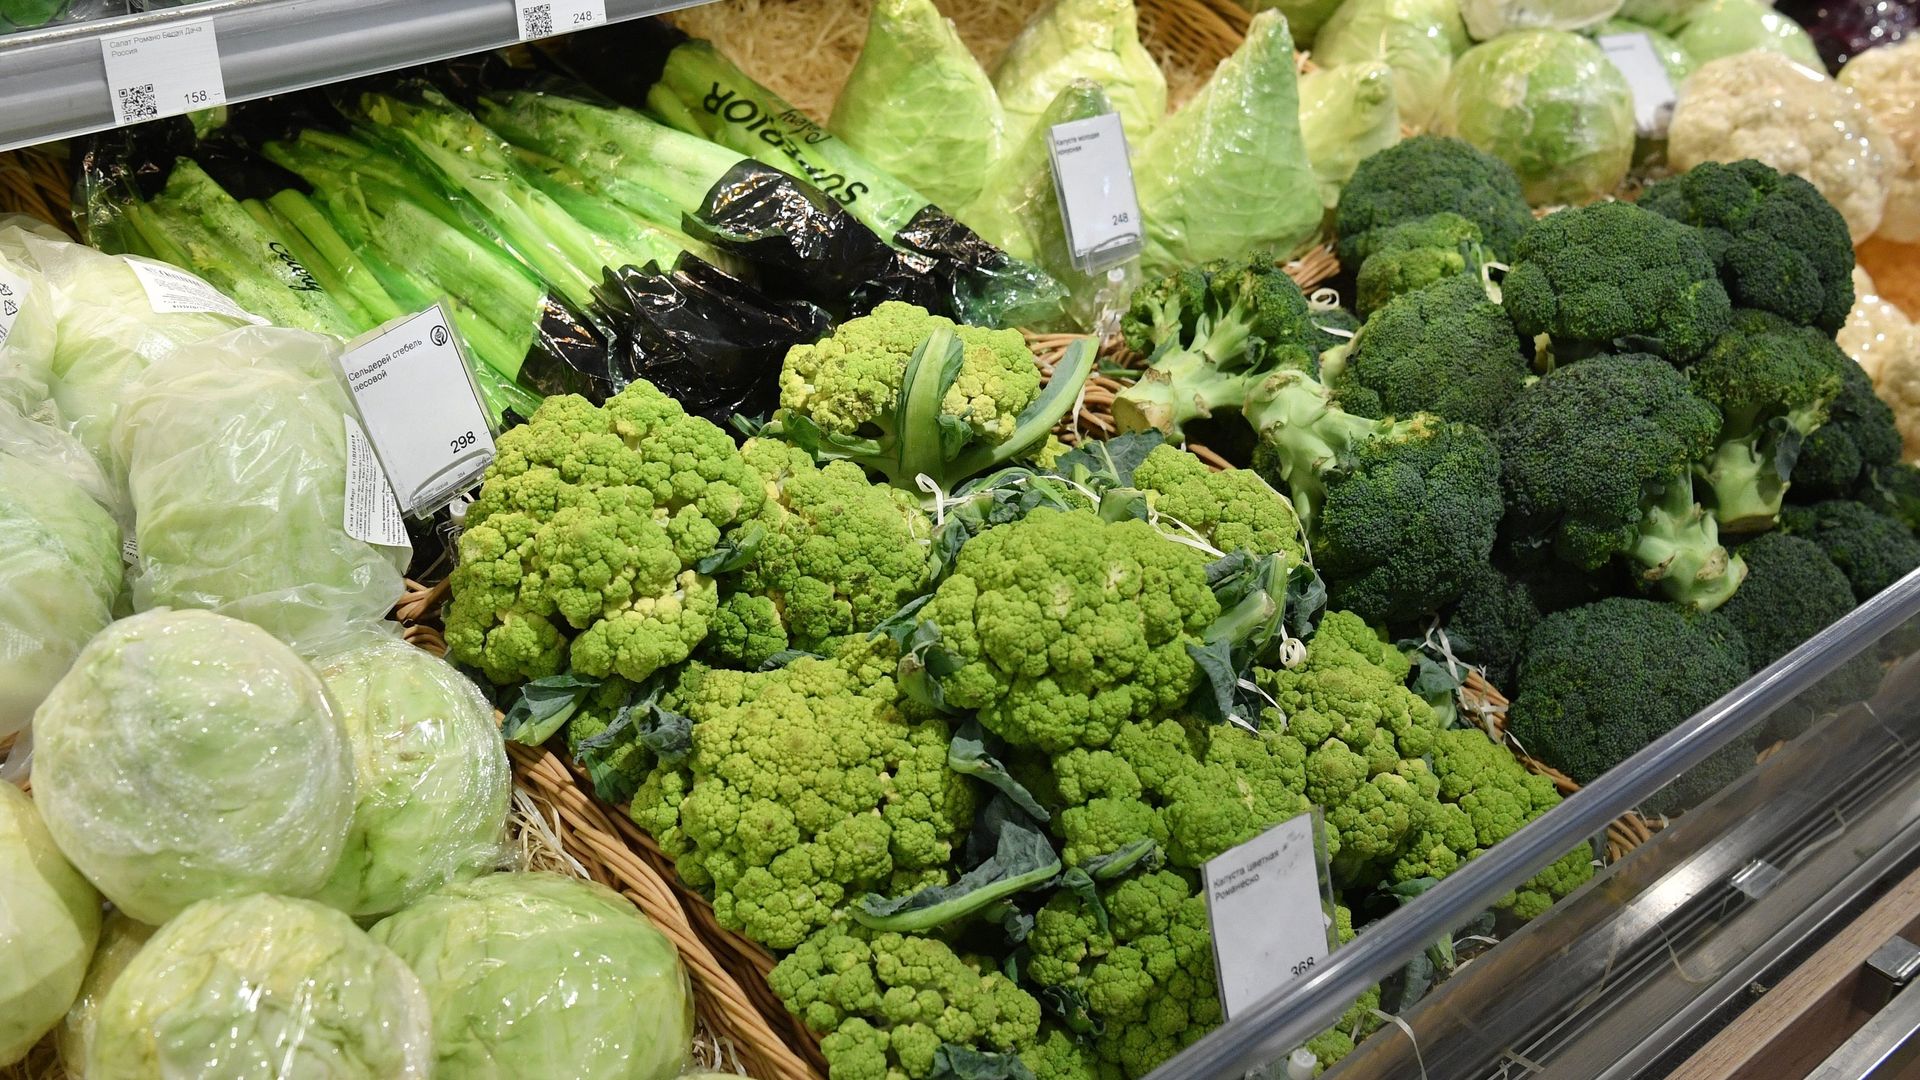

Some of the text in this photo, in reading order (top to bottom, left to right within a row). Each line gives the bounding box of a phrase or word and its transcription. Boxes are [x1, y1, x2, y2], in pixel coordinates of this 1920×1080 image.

[110, 39, 132, 49] Салат
[133, 34, 161, 44] Романо
[185, 26, 202, 36] Дача
[111, 47, 138, 57] Россия
[348, 338, 423, 382] Сельдерей стебель
[353, 369, 388, 393] весовой
[1213, 850, 1279, 888] Капуста цветная
[1215, 873, 1260, 902] Романеско
